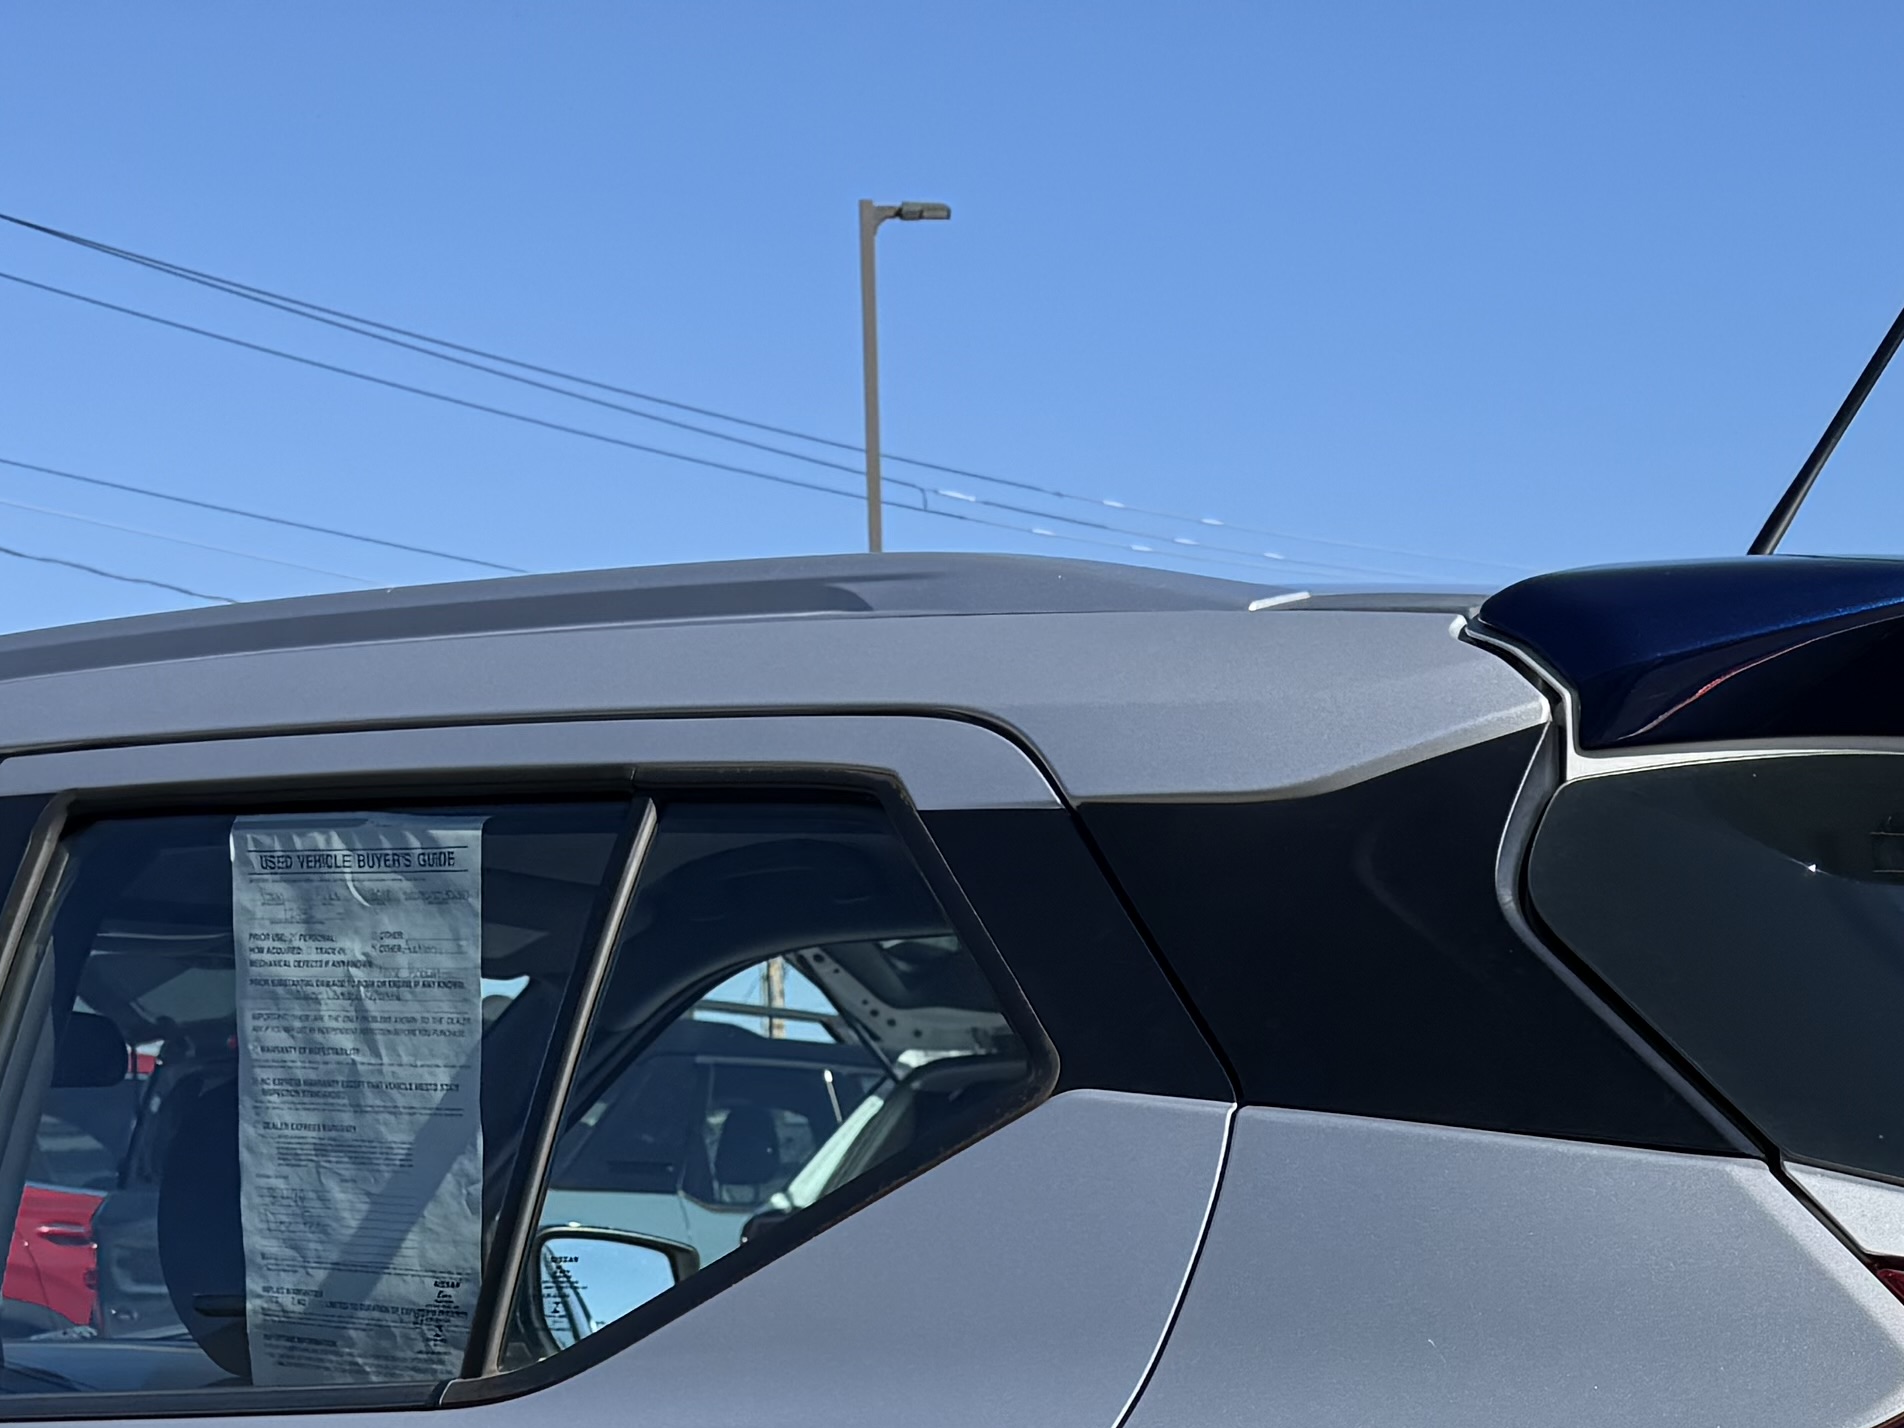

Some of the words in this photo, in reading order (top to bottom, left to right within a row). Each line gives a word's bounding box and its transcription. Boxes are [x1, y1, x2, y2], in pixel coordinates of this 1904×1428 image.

[259, 854, 294, 870] USED
[297, 853, 353, 869] VEHICLE
[357, 852, 412, 869] BUYER'S
[417, 851, 456, 868] GUIDE
